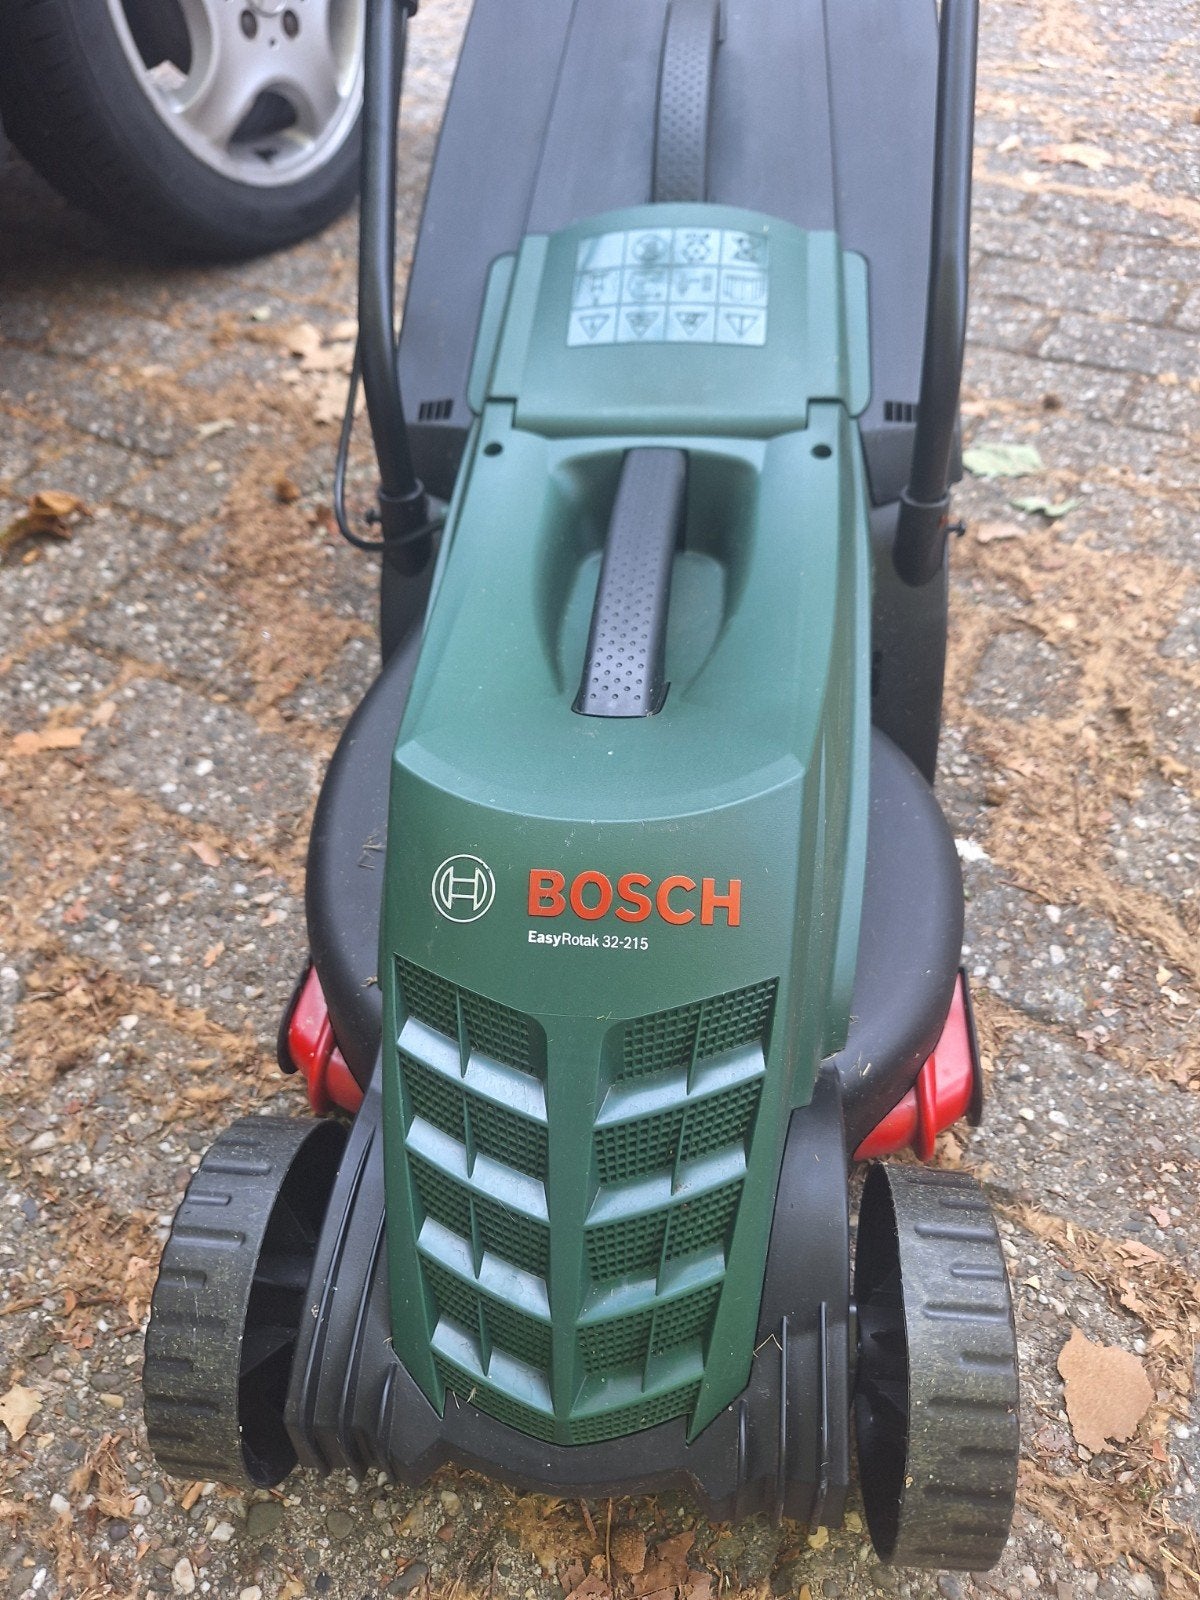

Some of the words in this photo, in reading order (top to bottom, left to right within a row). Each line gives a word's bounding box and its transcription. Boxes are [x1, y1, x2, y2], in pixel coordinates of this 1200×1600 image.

[527, 868, 742, 927] BOSCH
[528, 930, 599, 948] EasyRotak
[602, 935, 649, 950] 32-215
